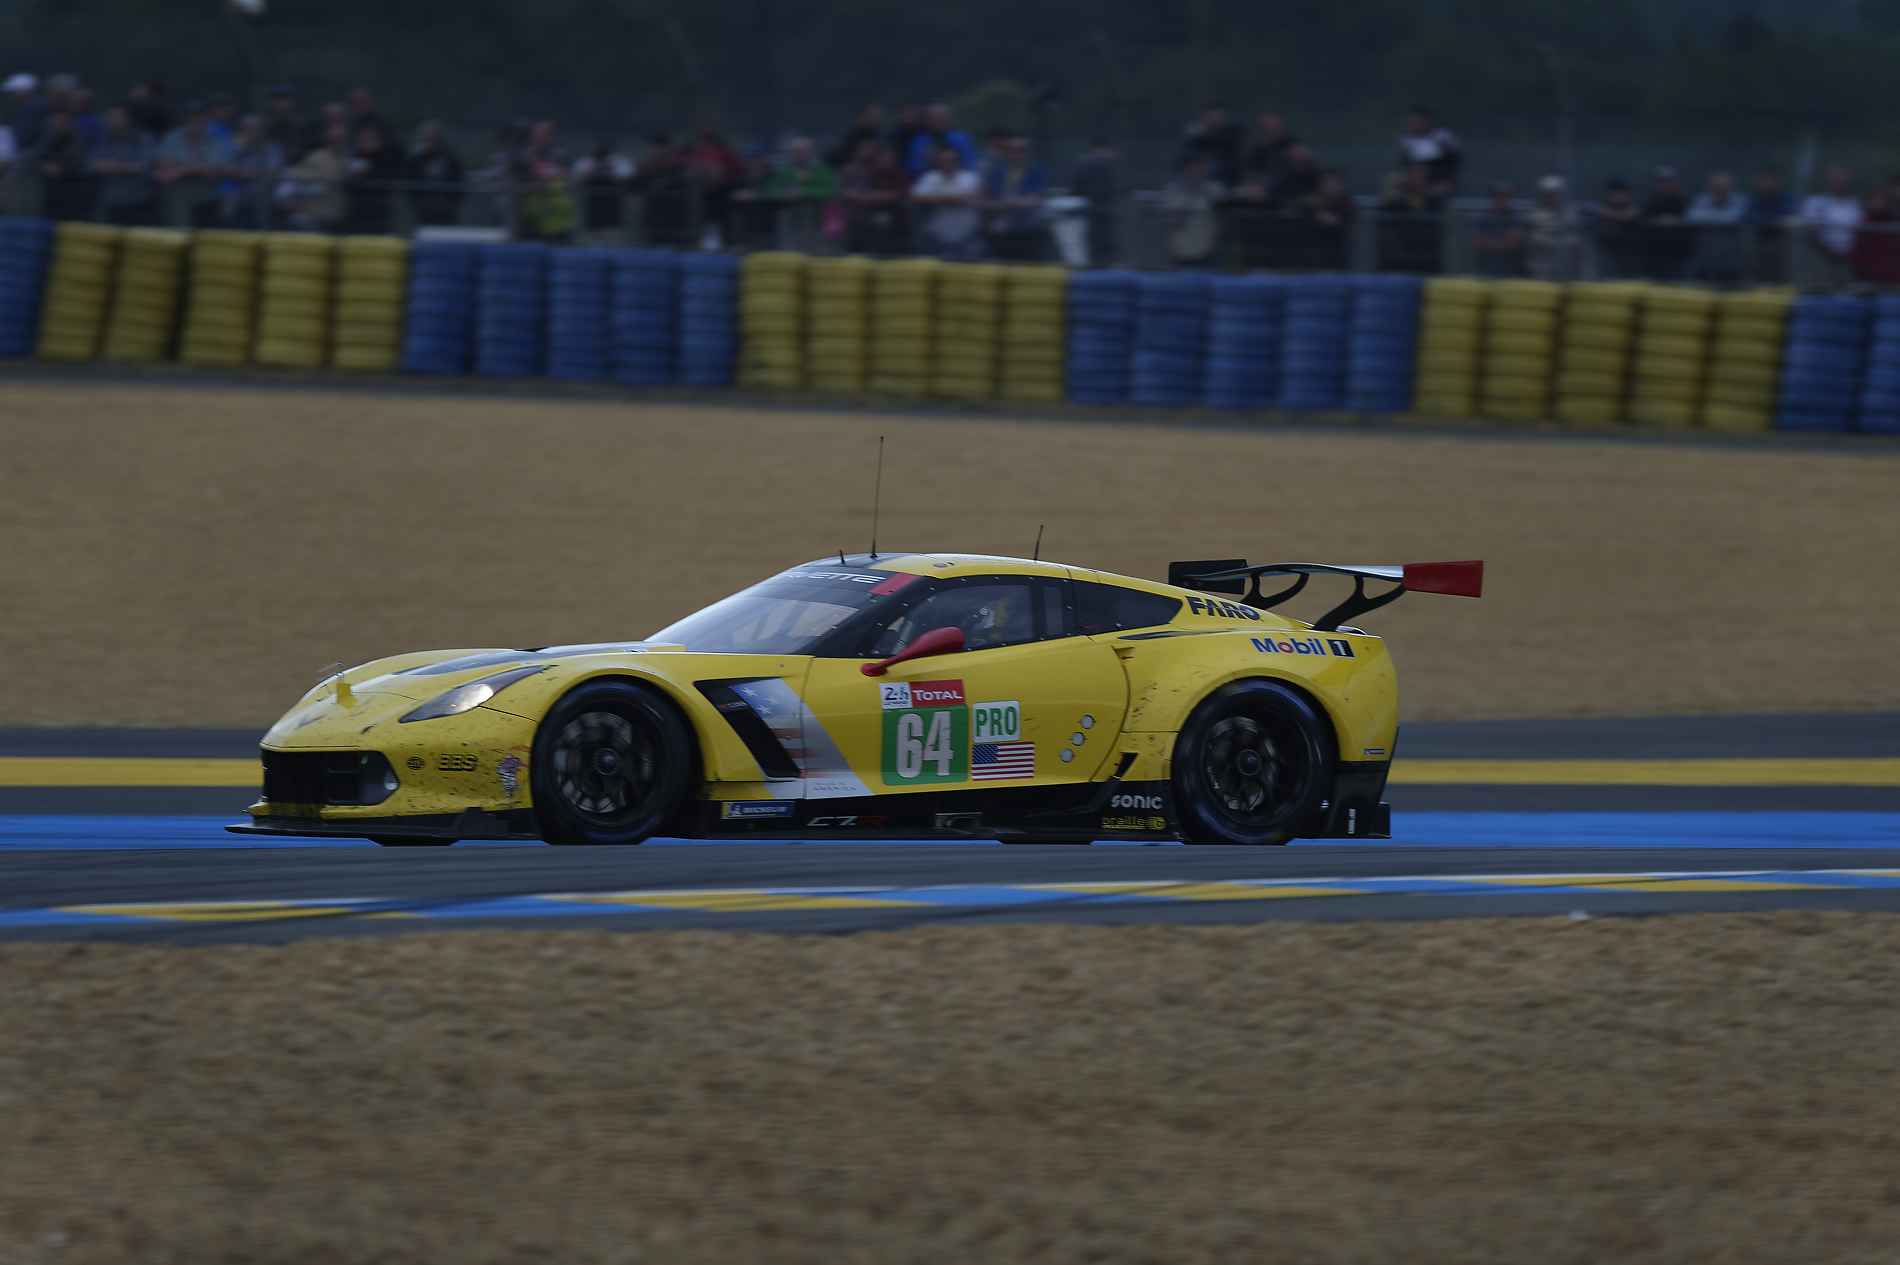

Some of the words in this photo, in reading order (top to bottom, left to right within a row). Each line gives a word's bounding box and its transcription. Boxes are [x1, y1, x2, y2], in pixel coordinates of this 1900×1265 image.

[1249, 638, 1326, 656] Mobil
[975, 705, 1017, 737] PRO
[895, 710, 955, 779] 64
[437, 753, 479, 772] BBS
